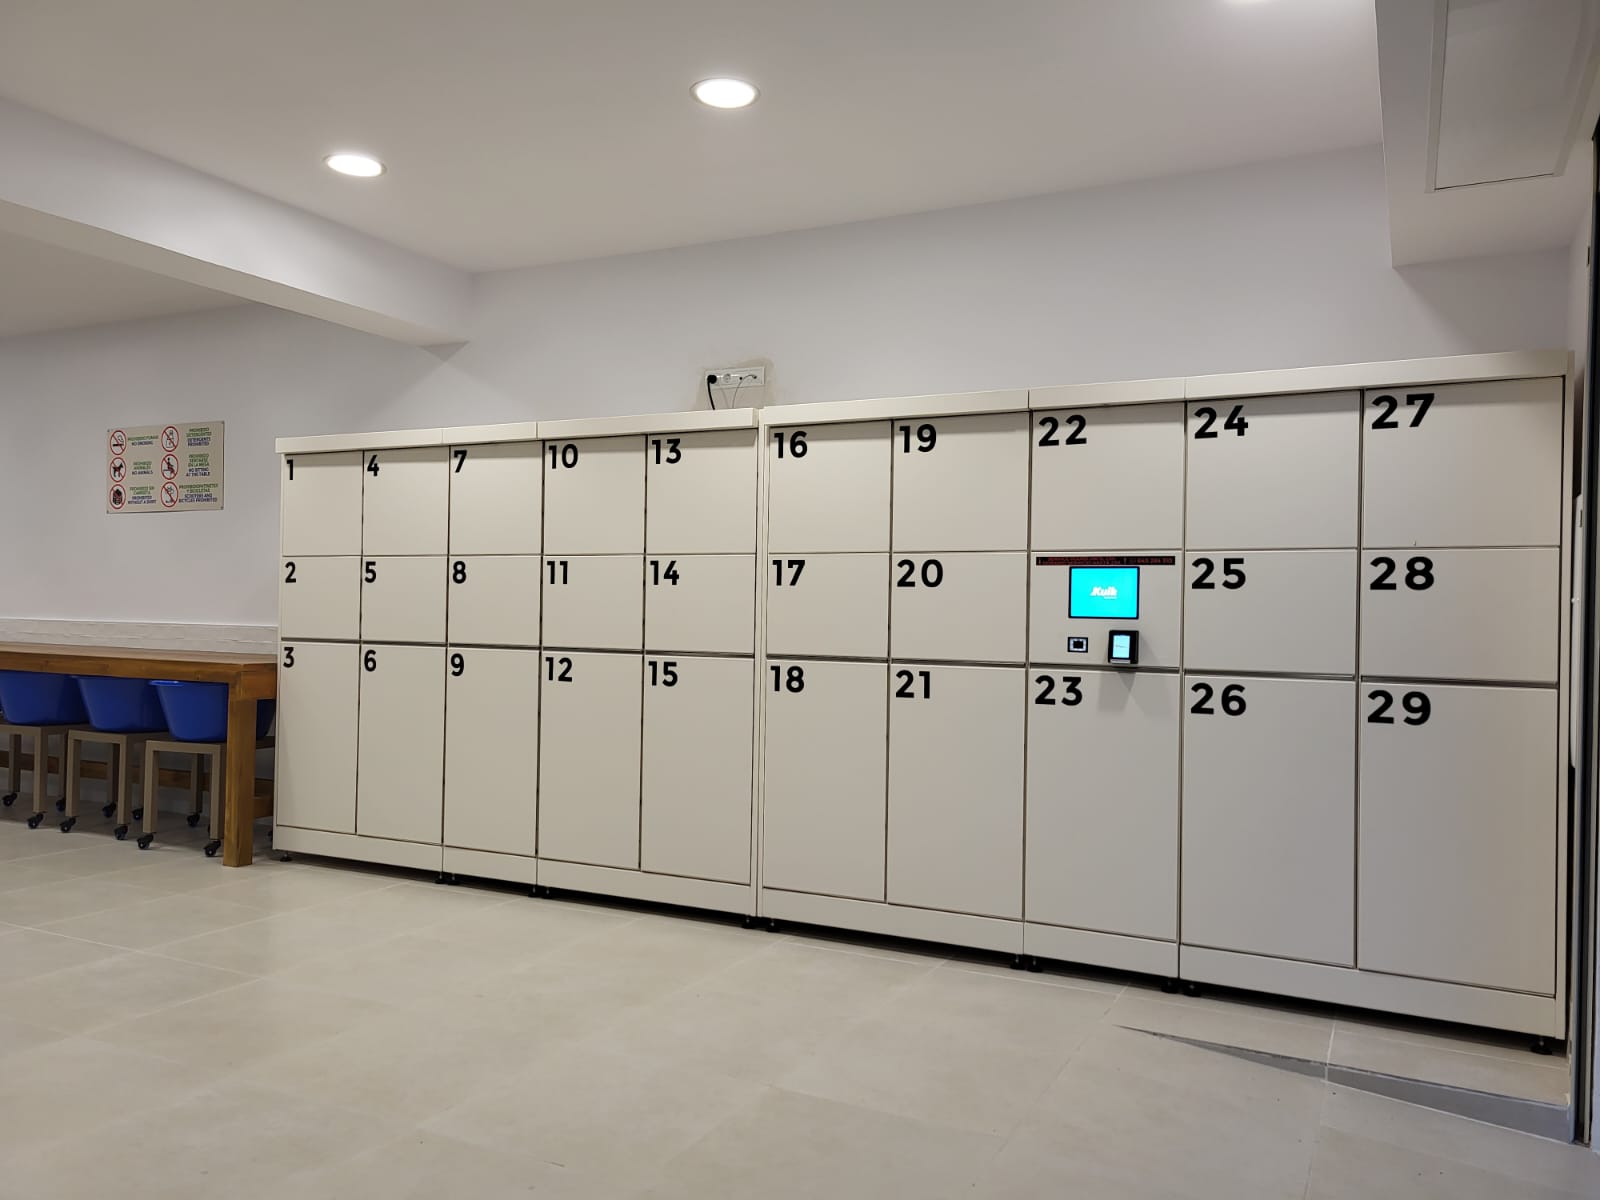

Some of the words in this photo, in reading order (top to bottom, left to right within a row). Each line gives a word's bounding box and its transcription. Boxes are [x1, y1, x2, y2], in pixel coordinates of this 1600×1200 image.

[1194, 405, 1248, 439] 24
[1372, 393, 1435, 429] 27
[899, 424, 936, 453] 19
[1039, 415, 1086, 446] 22
[549, 444, 579, 470] 10
[652, 438, 682, 465] 13
[774, 431, 807, 458] 16
[286, 459, 294, 481] 1
[367, 454, 380, 477] 4
[454, 450, 467, 473] 7
[285, 562, 297, 584] 2
[364, 561, 377, 583] 5
[453, 561, 467, 585] 8
[547, 561, 568, 585] 11
[650, 561, 680, 586] 14
[773, 560, 806, 586] 17
[897, 560, 944, 588] 20
[1192, 558, 1246, 590] 25
[1370, 556, 1435, 591] 28
[283, 646, 295, 669] 3
[364, 650, 377, 672] 6
[451, 653, 465, 677] 9
[546, 657, 573, 683] 12
[649, 661, 678, 687] 15
[771, 665, 805, 693] 18
[896, 670, 931, 699] 21
[1035, 675, 1083, 706] 23
[1191, 683, 1247, 717] 26
[1368, 690, 1432, 726] 29
